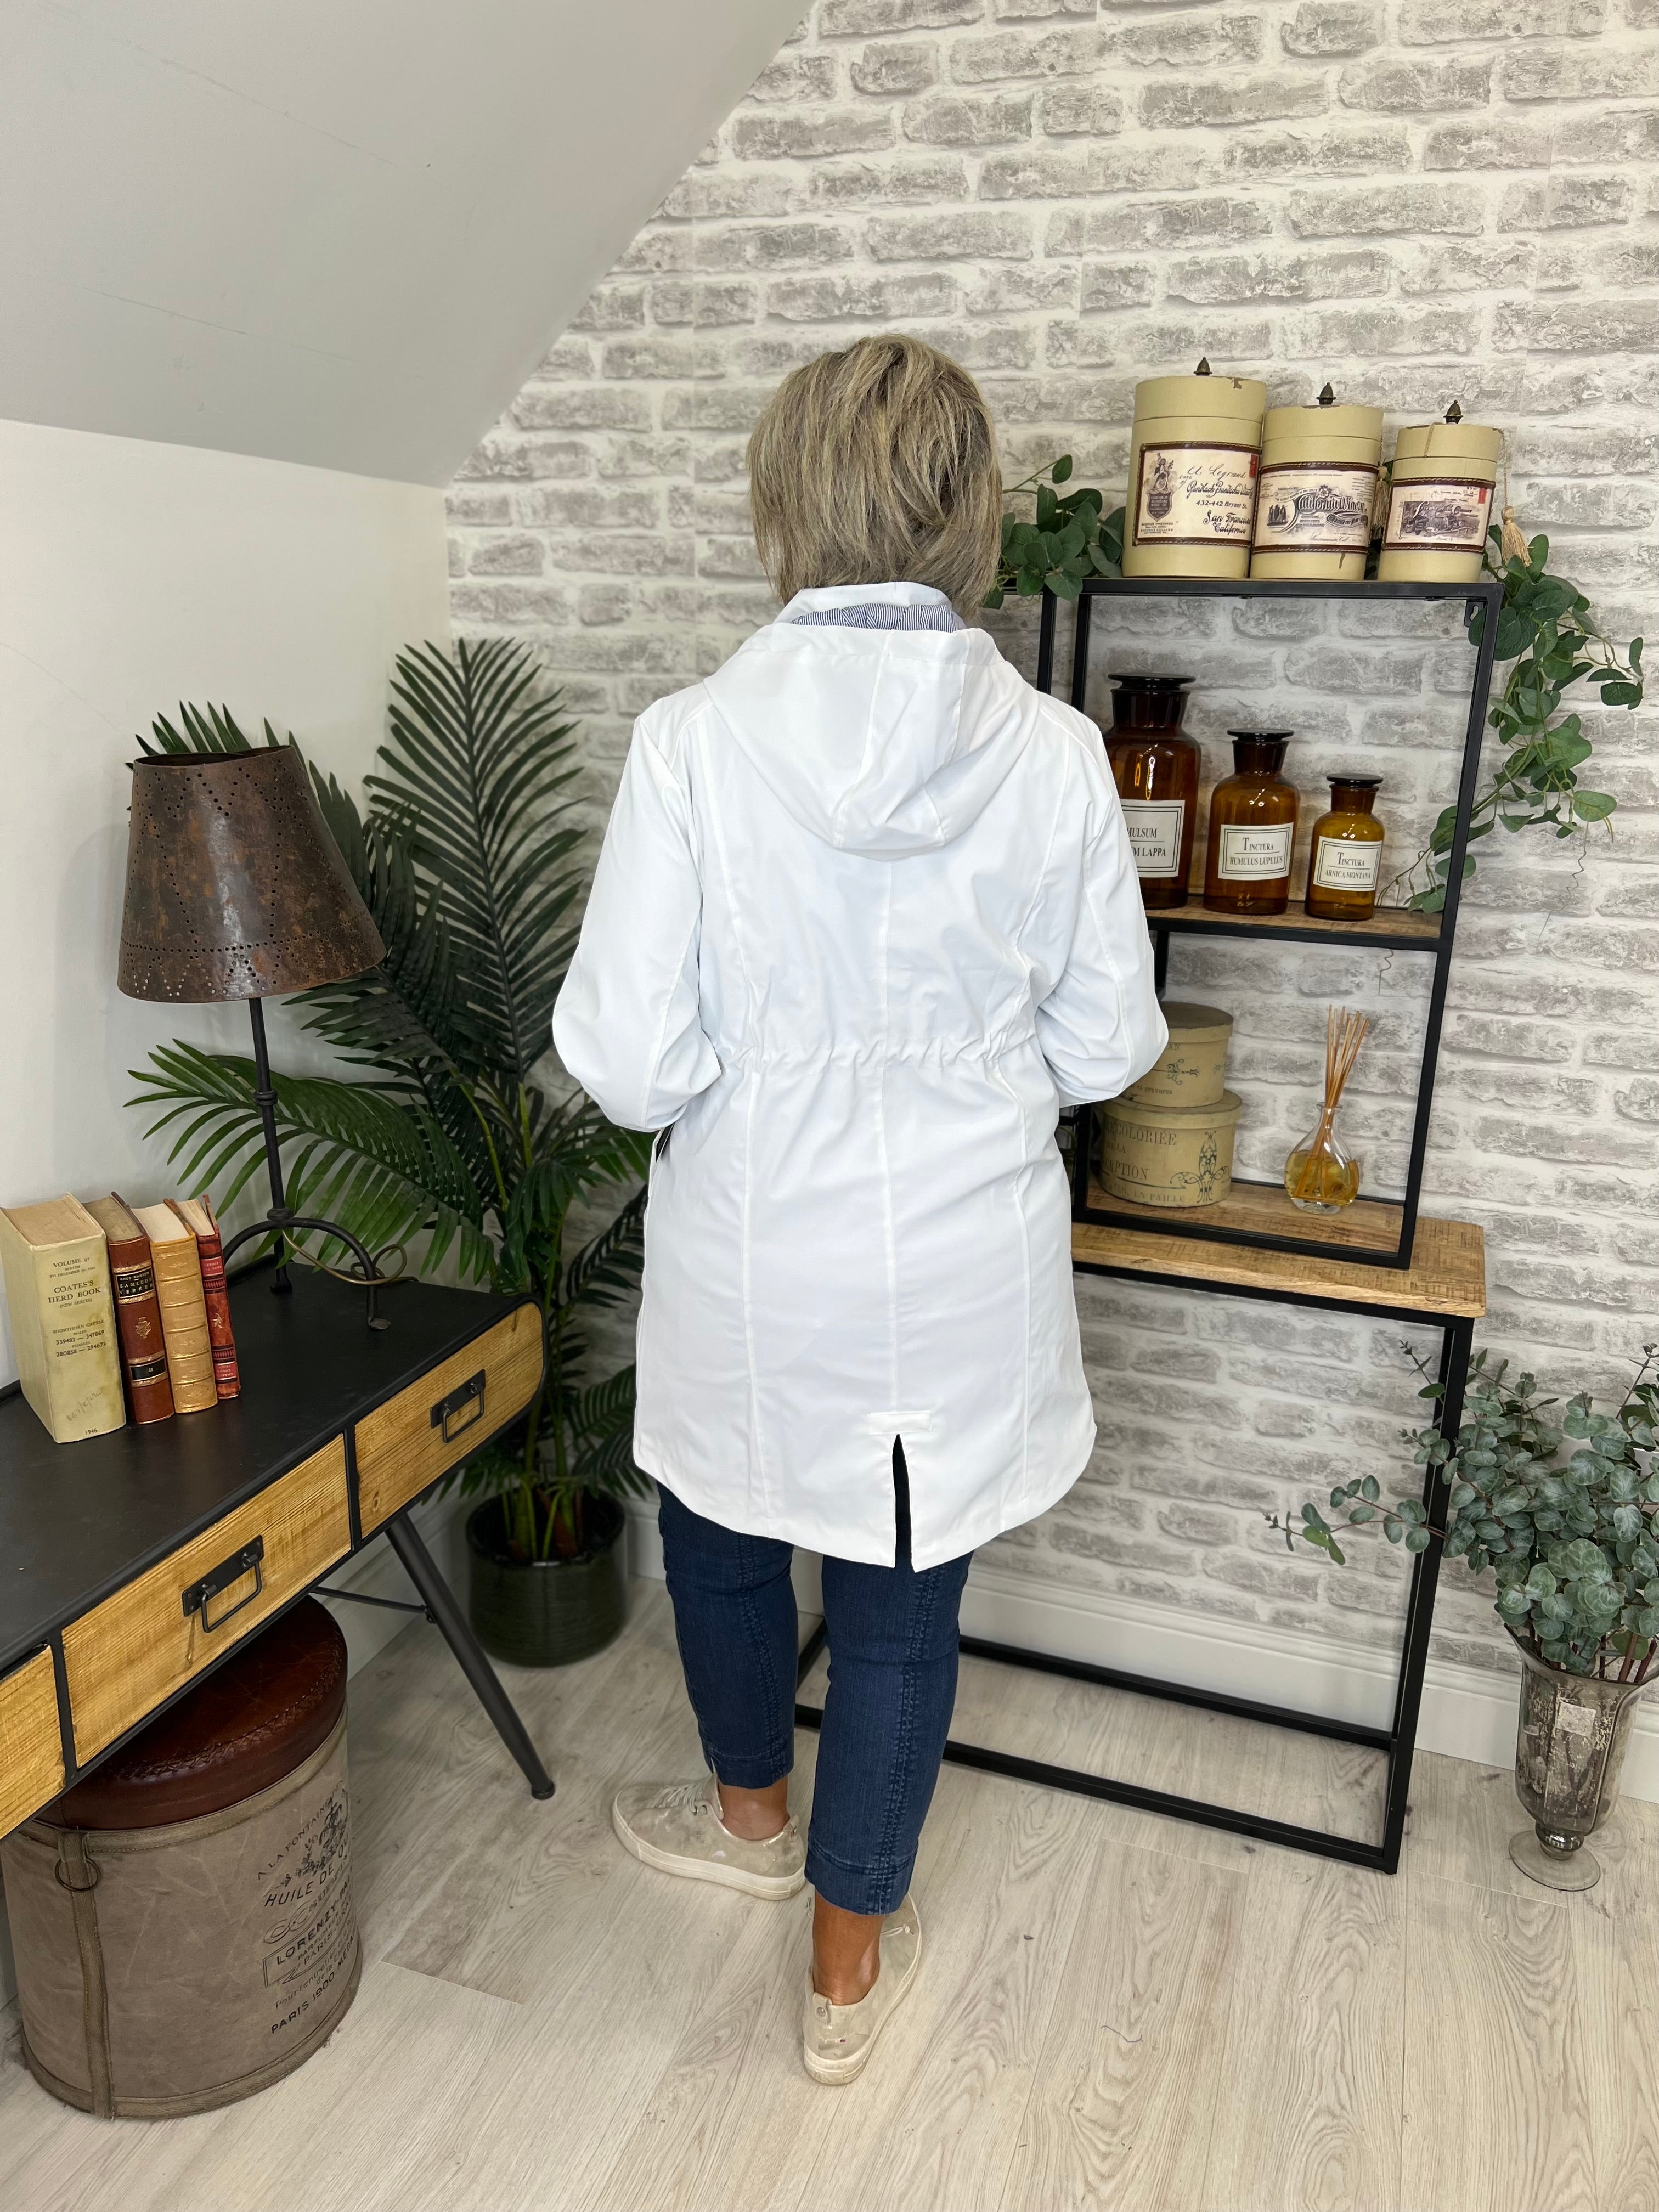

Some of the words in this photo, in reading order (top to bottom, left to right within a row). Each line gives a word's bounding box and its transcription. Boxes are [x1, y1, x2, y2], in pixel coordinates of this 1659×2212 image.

[1298, 494, 1341, 515] California
[1203, 510, 1224, 525] San
[1212, 522, 1246, 535] California
[1126, 827, 1158, 838] MULSUM
[1142, 848, 1166, 857] LAPPA
[1229, 856, 1259, 865] HUMULUS
[1260, 856, 1283, 865] LUPULUS
[1325, 870, 1345, 878] ARNICA
[1144, 1087, 1173, 1095] gravures
[1116, 1144, 1125, 1154] LA
[53, 1258, 81, 1267] VOLUME
[54, 1280, 94, 1294] COATES'S
[48, 1294, 74, 1304] HERD
[78, 1287, 101, 1298] BOOK
[53, 1324, 84, 1334] SHORTHORN
[86, 1330, 104, 1339] 347869
[88, 1341, 106, 1351] 294673
[268, 1854, 284, 1869] LA
[264, 1880, 314, 1907] HUILE
[320, 1864, 334, 1886] DE
[271, 2001, 309, 2034] PARIS
[313, 1972, 335, 2001] 1900
